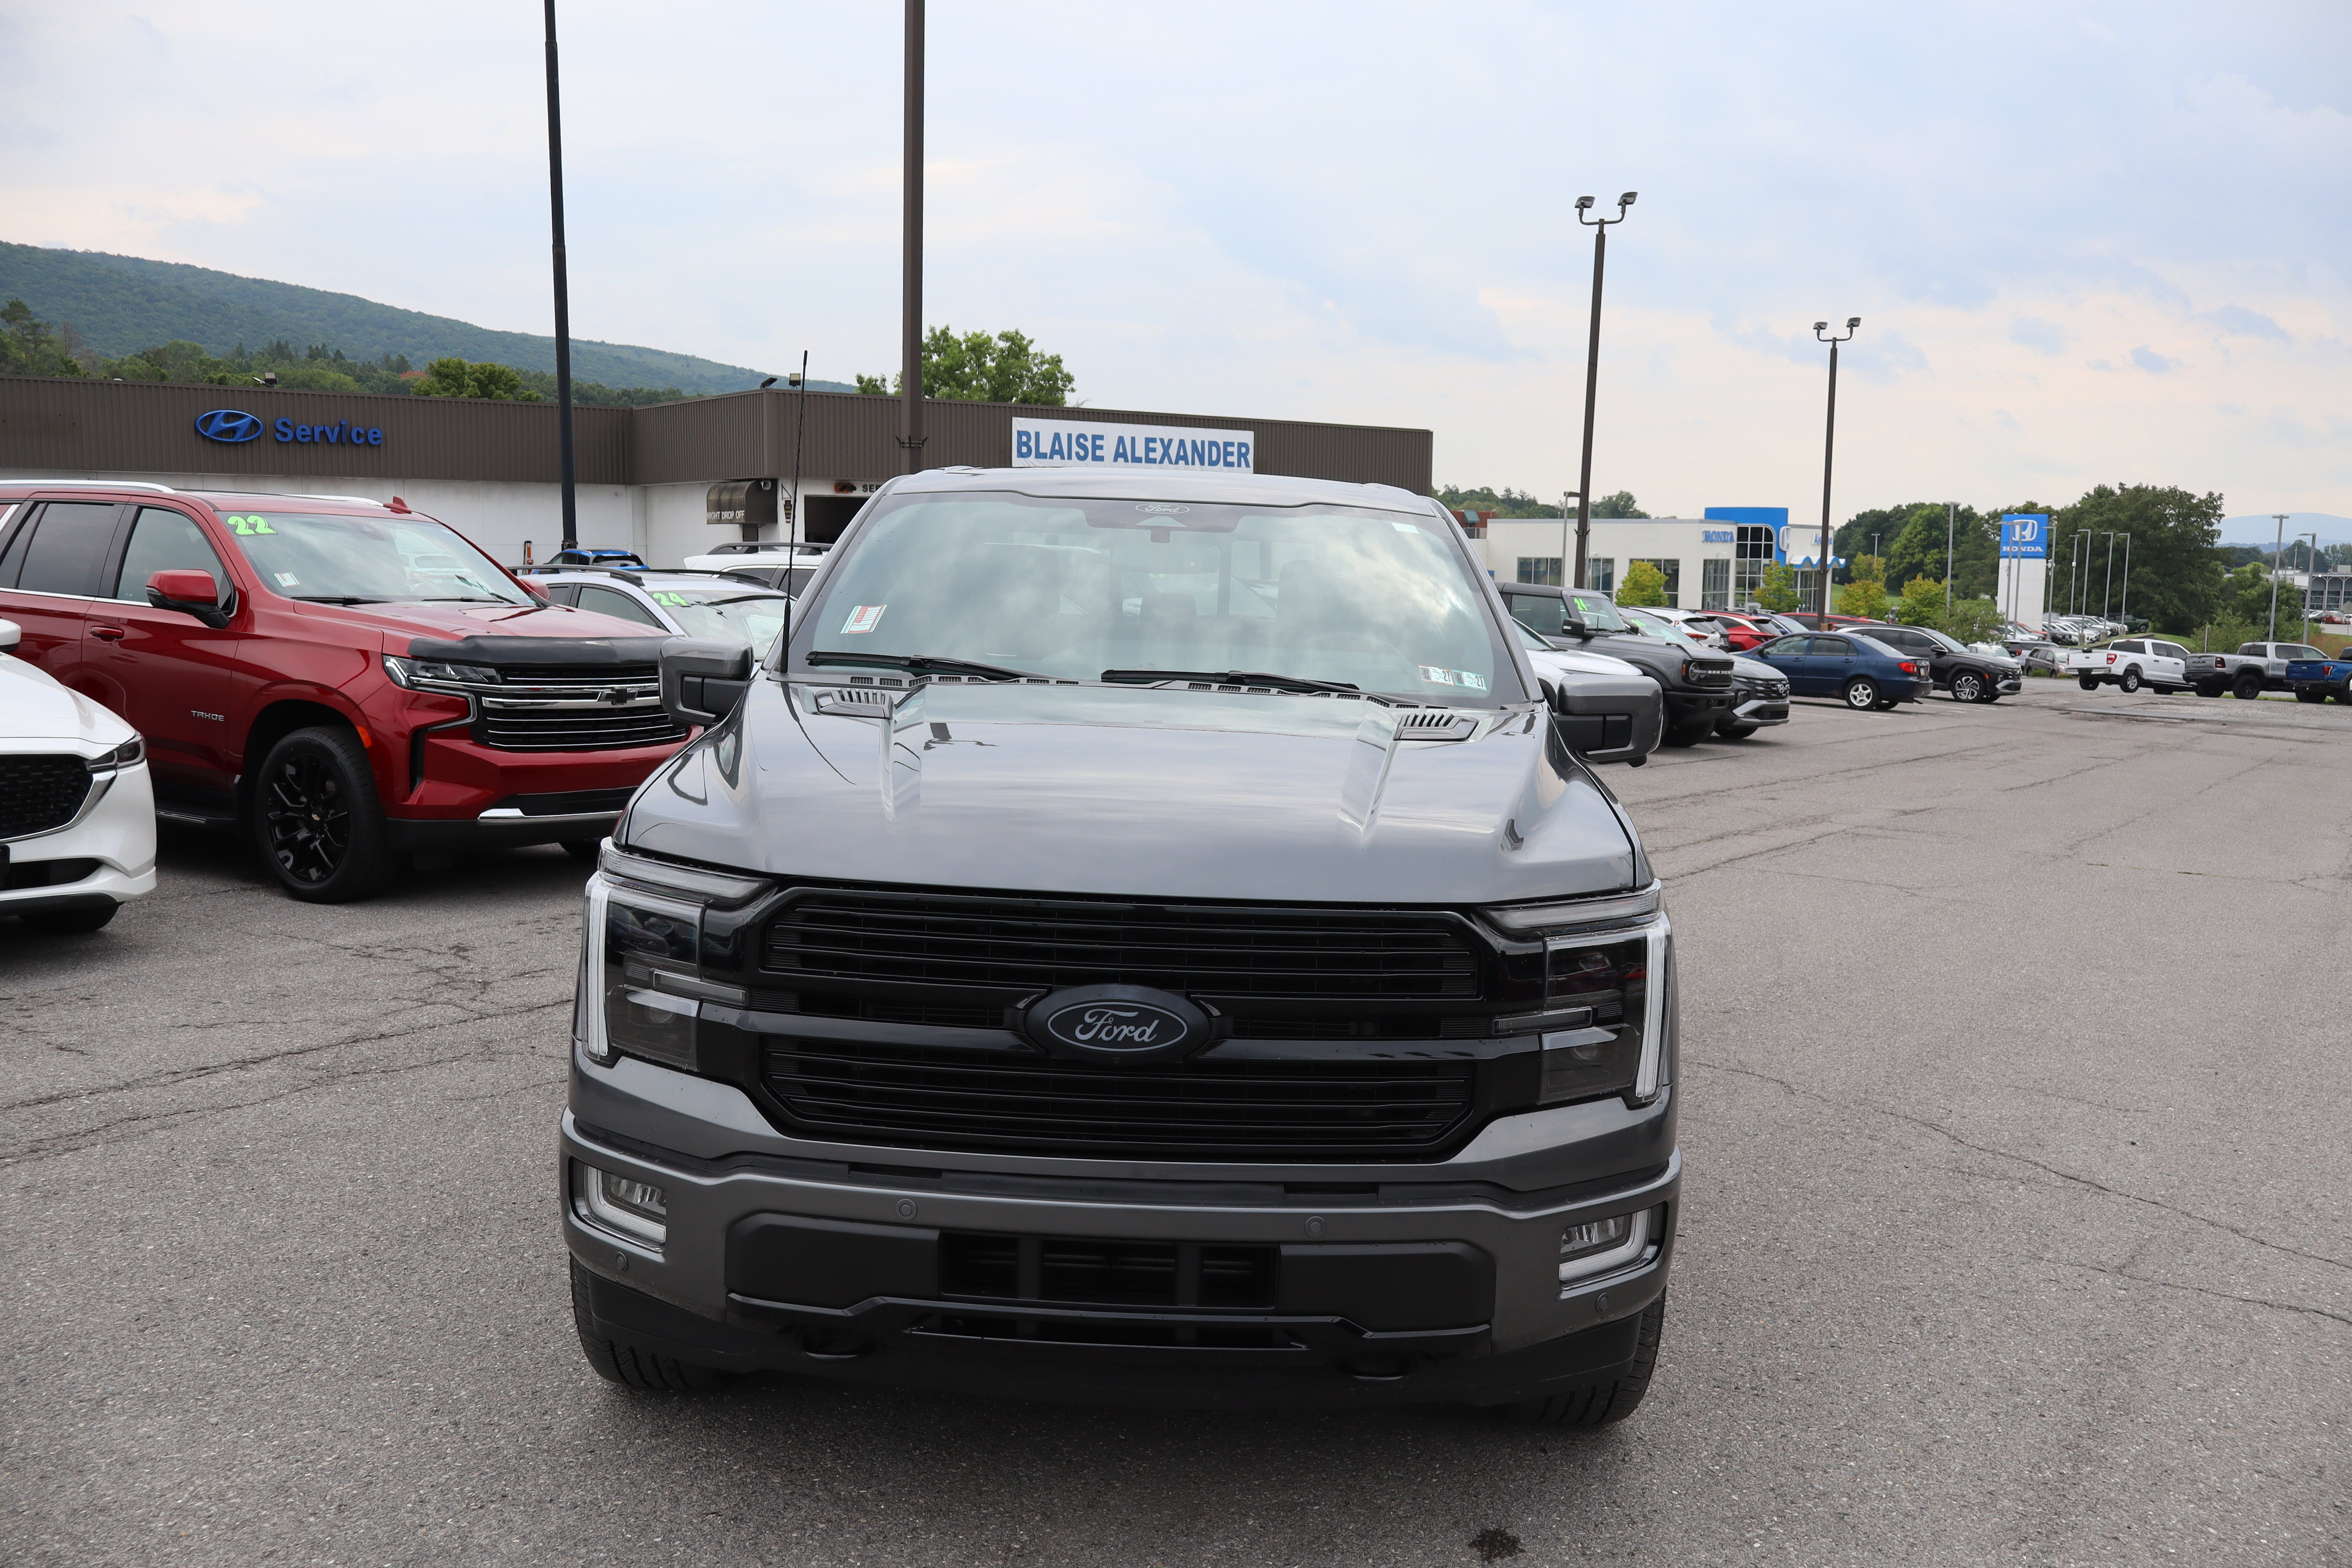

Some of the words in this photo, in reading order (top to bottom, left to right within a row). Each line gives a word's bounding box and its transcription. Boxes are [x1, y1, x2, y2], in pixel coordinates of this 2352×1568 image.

[274, 417, 383, 445] Service
[1016, 430, 1105, 462] BLAISE
[1112, 435, 1251, 468] ALEXANDER
[1145, 504, 1180, 512] Ford
[706, 511, 721, 520] NIGHT
[721, 510, 735, 520] DROP
[735, 510, 745, 519] OFF
[227, 515, 277, 536] 22
[1704, 530, 1735, 542] HONDA
[652, 592, 689, 606] 24
[1574, 597, 1588, 611] 24
[1442, 670, 1451, 683] 27
[1475, 675, 1484, 688] 27
[191, 710, 225, 722] TAHOE
[1074, 1008, 1160, 1042] Ford
